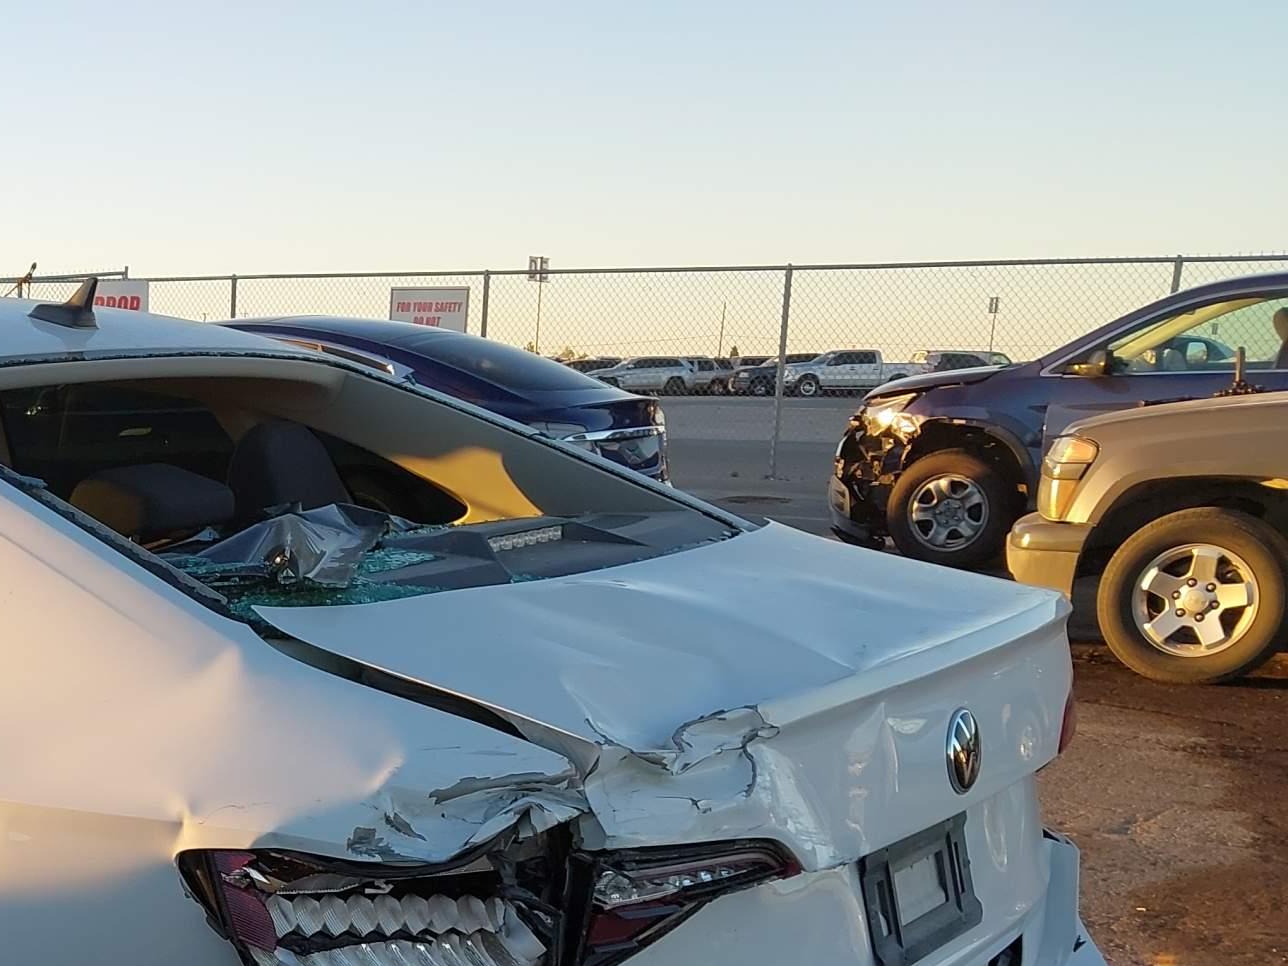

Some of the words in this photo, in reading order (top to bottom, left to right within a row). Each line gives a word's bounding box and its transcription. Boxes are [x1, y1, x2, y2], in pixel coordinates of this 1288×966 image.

[396, 301, 411, 313] FOR
[413, 301, 433, 313] YOUR
[434, 301, 463, 313] SAFETY
